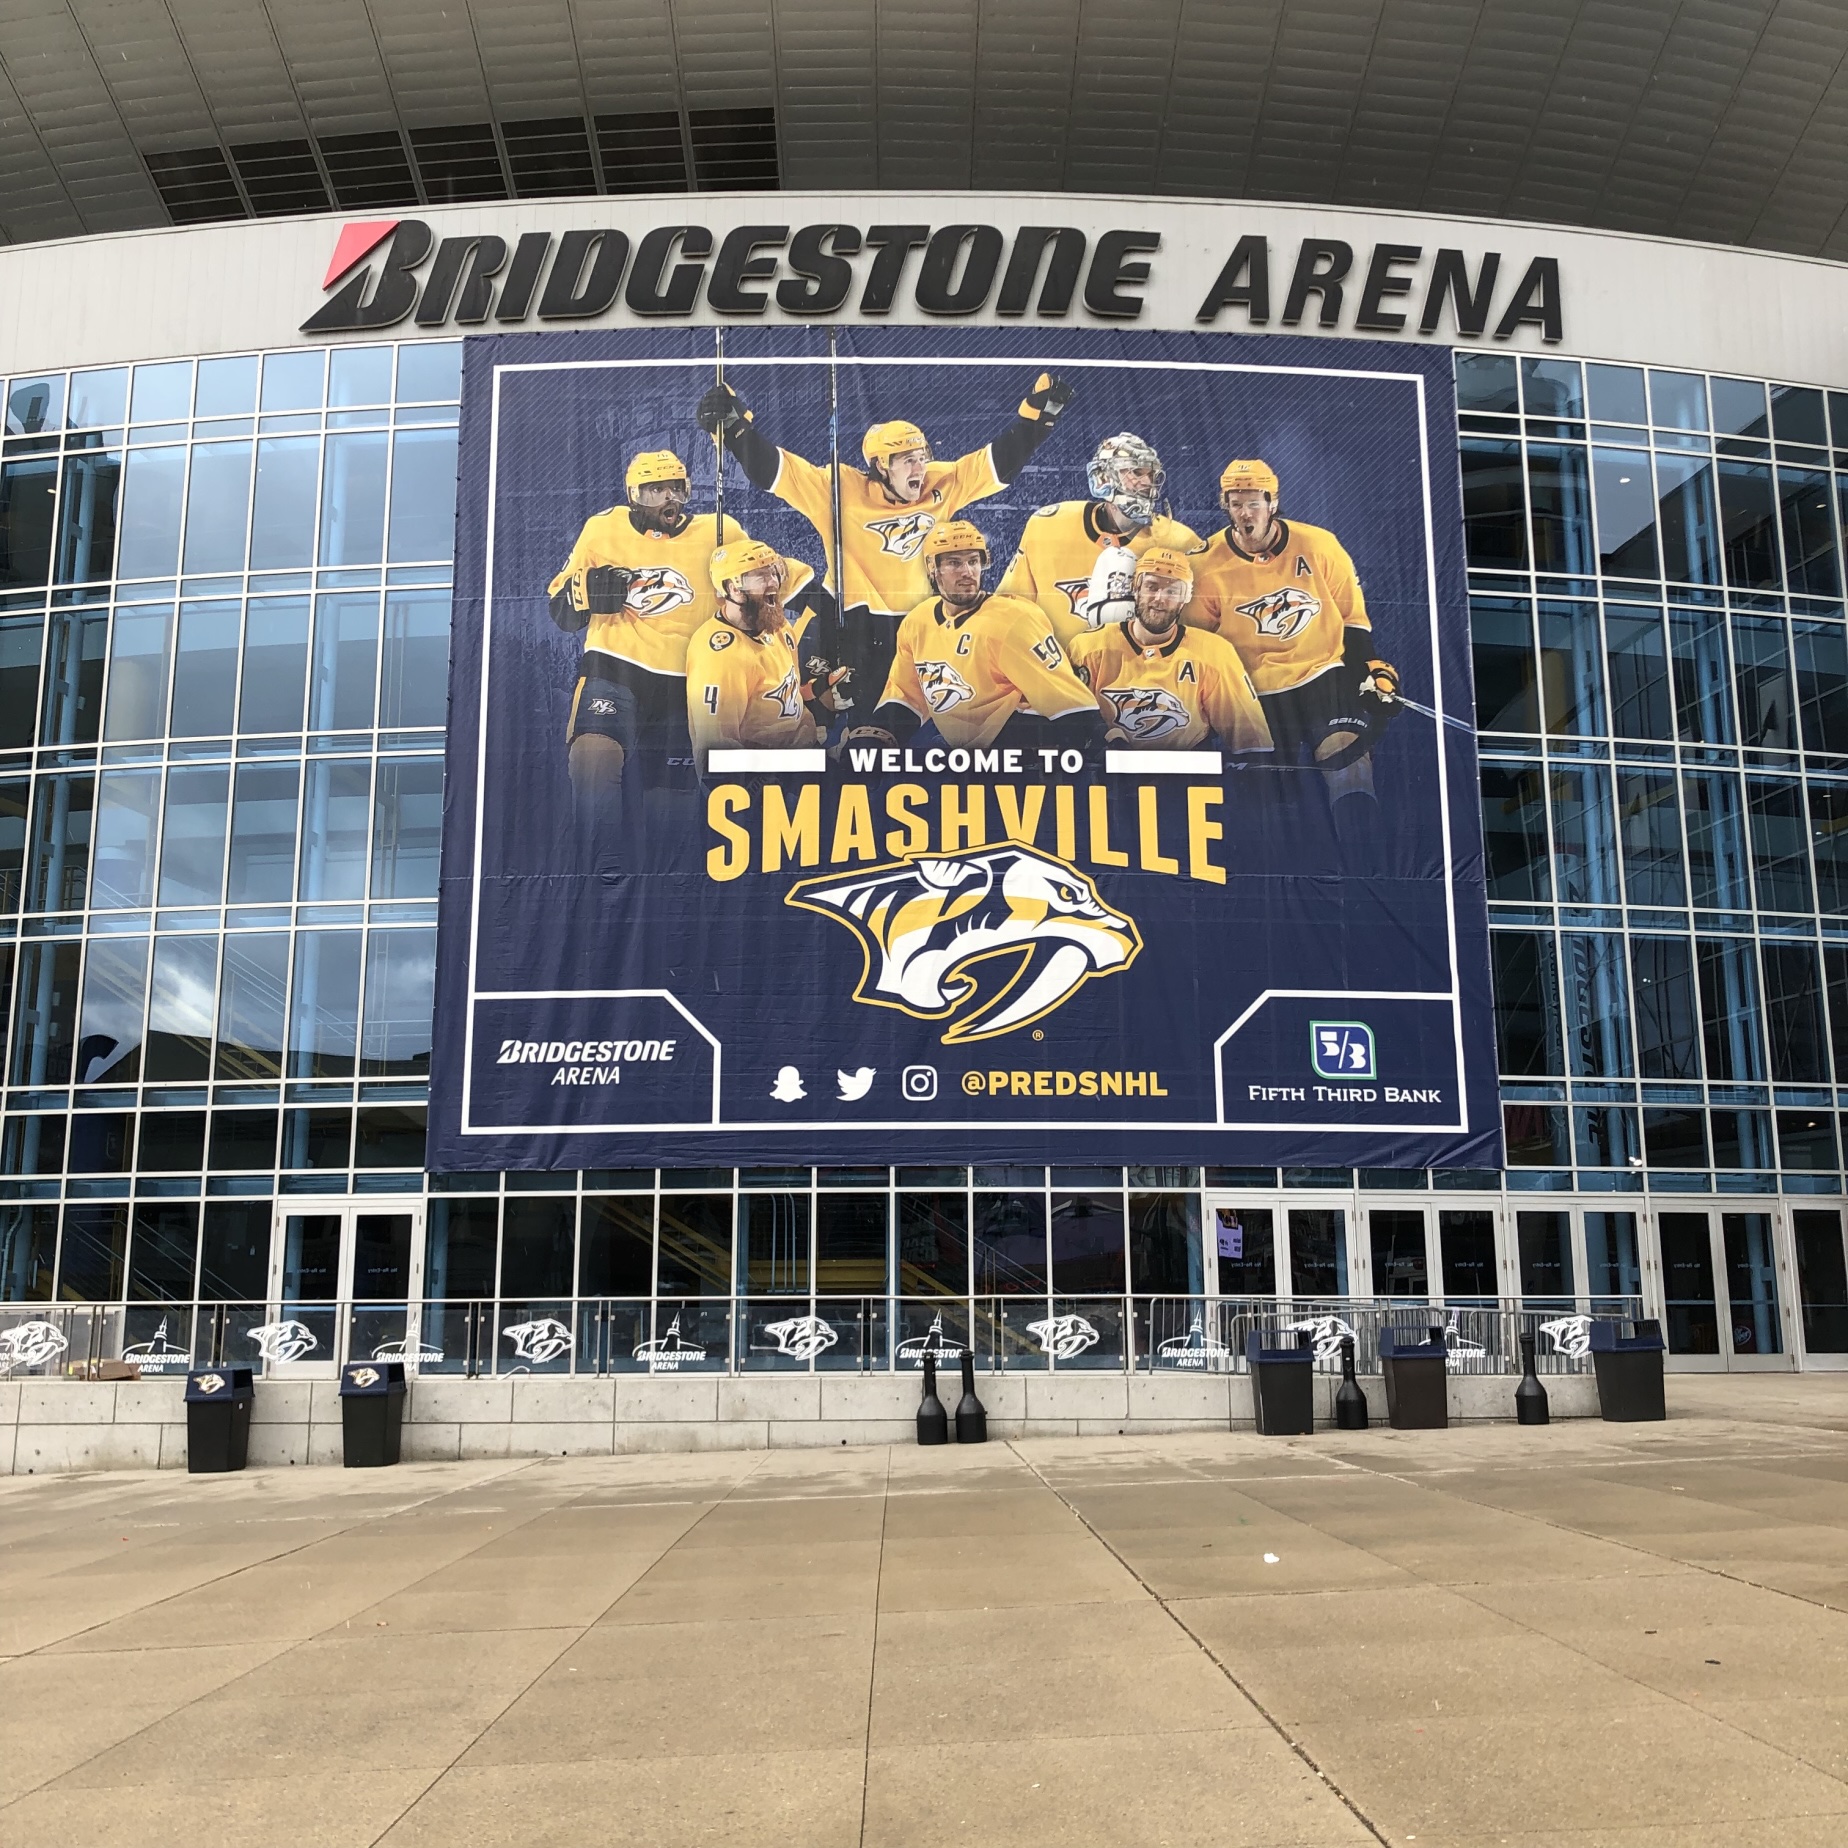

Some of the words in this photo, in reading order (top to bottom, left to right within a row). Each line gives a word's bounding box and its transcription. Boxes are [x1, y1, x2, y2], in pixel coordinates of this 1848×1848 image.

[299, 219, 1162, 333] BRIDGESTONE
[1195, 234, 1565, 344] ARENA
[1295, 555, 1313, 577] A
[956, 633, 971, 656] C
[1030, 635, 1062, 671] 59
[1177, 661, 1196, 684] A
[702, 684, 719, 716] 4
[848, 747, 1024, 774] WELCOME
[1038, 748, 1084, 774] TO
[706, 783, 1227, 886] SMASHVILLE
[496, 1039, 676, 1064] BRIDGESTONE
[551, 1066, 620, 1086] ARENA
[961, 1070, 1169, 1096] @PREDSNHL
[124, 1353, 190, 1364] BRIDGESTONE
[376, 1352, 444, 1363] BRIDGESTONE
[636, 1350, 707, 1361] BRIDGESTONE
[1161, 1347, 1230, 1358] BRIDGESTONE
[1177, 1359, 1204, 1367] ARENA
[651, 1362, 679, 1370] ARENA
